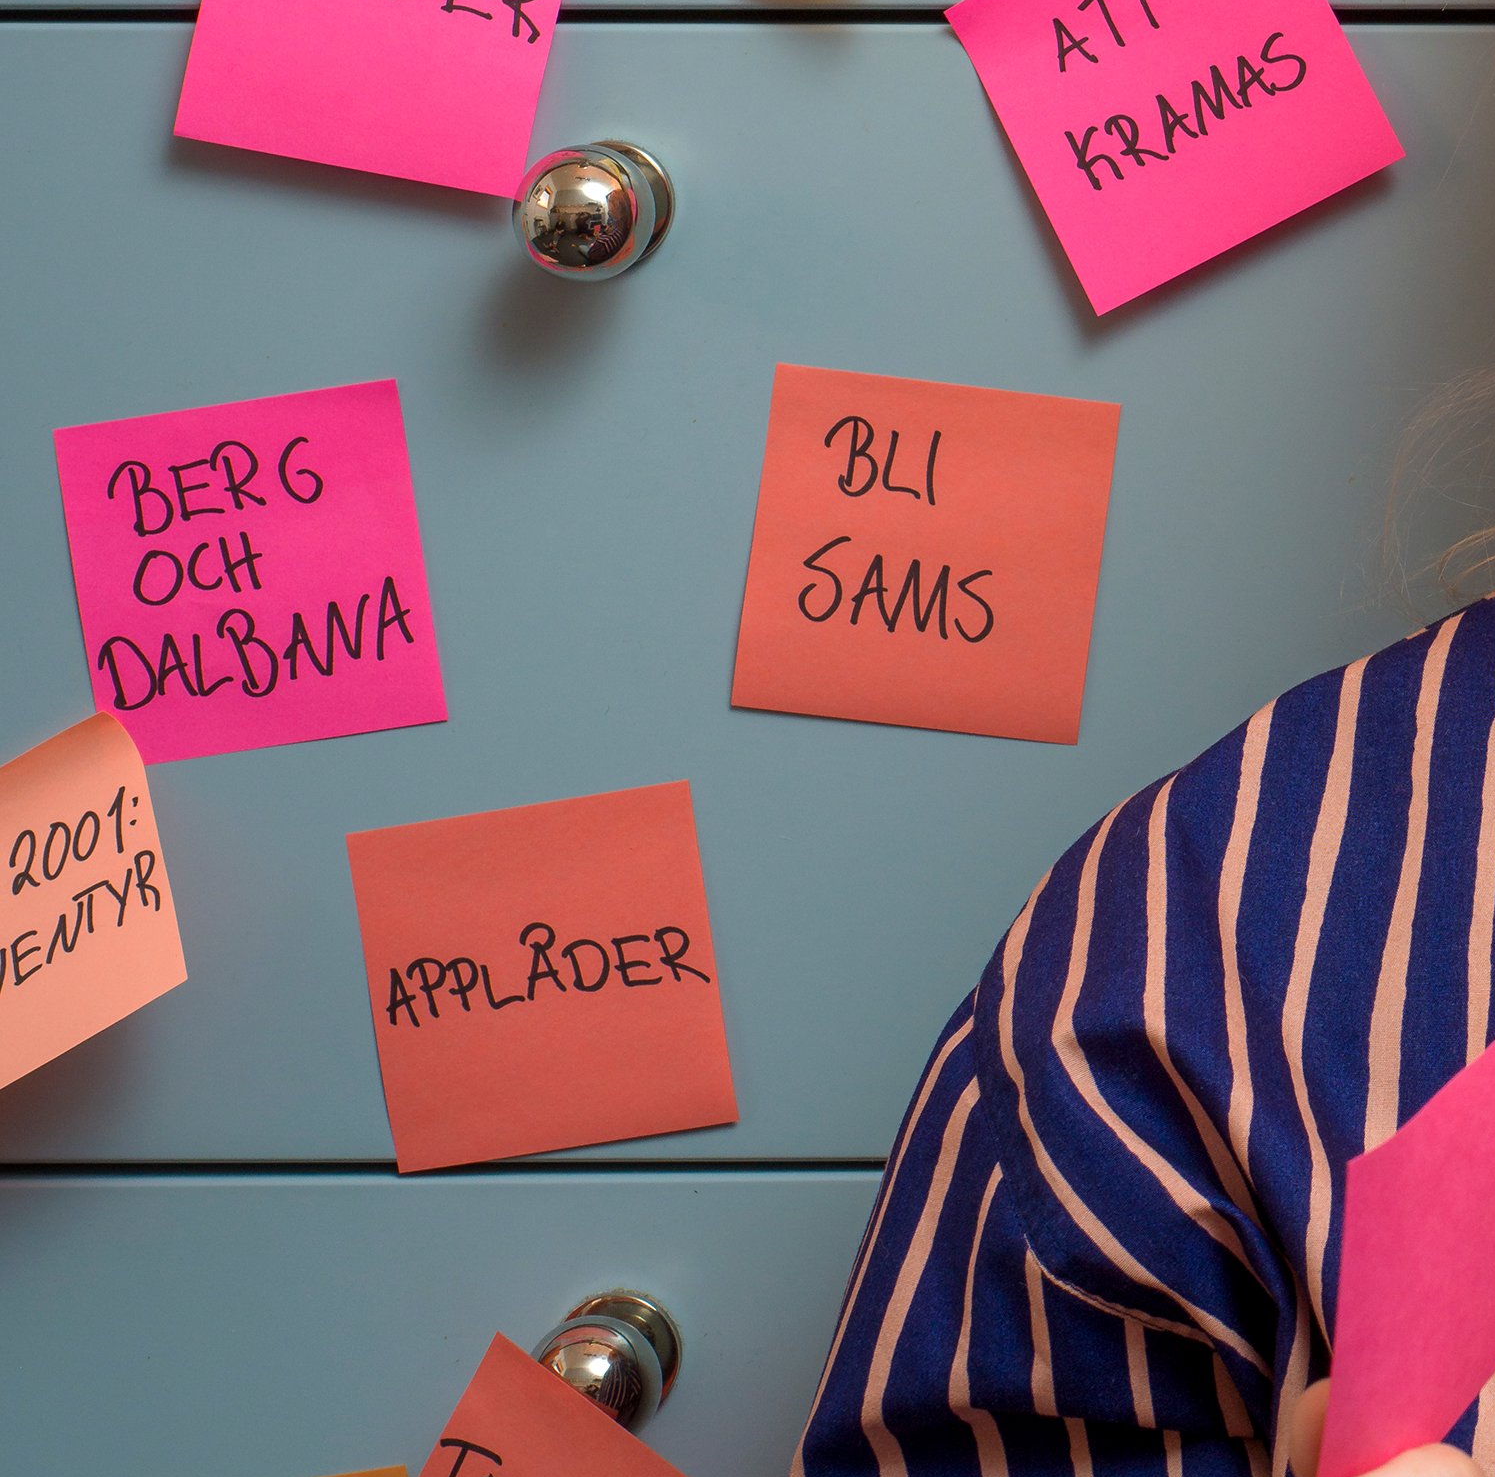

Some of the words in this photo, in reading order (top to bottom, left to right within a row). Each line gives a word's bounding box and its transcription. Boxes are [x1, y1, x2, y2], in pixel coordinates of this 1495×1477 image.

[1066, 32, 1307, 190] KRAMAS
[107, 437, 323, 537] BERG
[824, 415, 942, 506] BLI
[133, 532, 263, 606] OCH
[798, 535, 994, 643] SAMS
[98, 576, 414, 711] DALBANA
[9, 785, 139, 895] 2001:
[385, 922, 710, 1029] APPLÅDER
